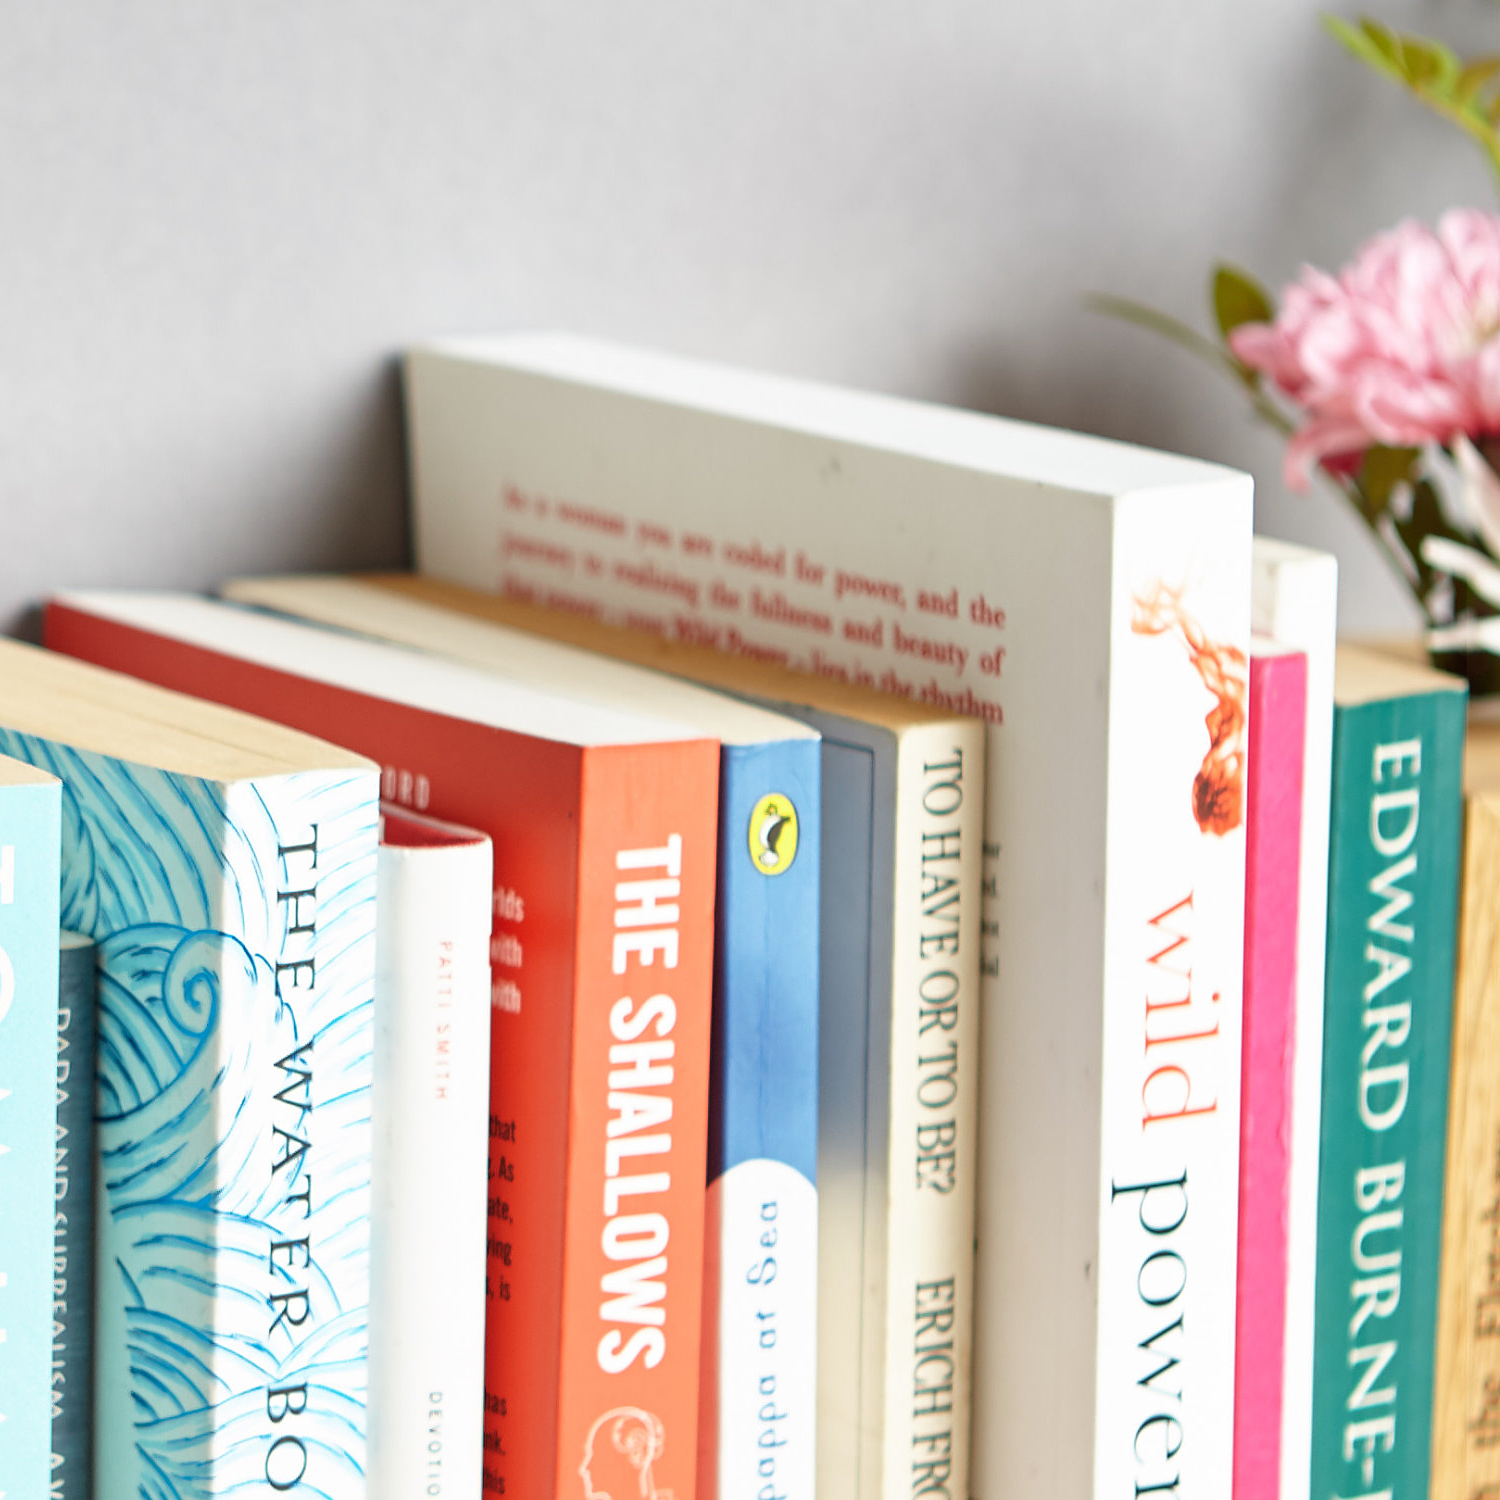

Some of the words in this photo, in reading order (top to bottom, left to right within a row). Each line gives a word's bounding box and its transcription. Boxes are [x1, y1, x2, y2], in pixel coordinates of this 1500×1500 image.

[843, 613, 884, 652] and
[893, 619, 969, 679] beauty
[979, 646, 1006, 678] of
[915, 585, 959, 622] and
[969, 593, 1006, 632] the
[922, 747, 963, 816] TO
[274, 823, 318, 998] THE
[612, 832, 682, 975] THE
[920, 827, 961, 960] HAVE
[1357, 736, 1422, 1133] EDWARD
[436, 940, 453, 1010] PATTI
[918, 970, 959, 1037] OR
[1142, 889, 1220, 1133] wild
[434, 1023, 452, 1101] SMITH
[917, 1039, 958, 1109] TO
[267, 1039, 314, 1340] WATER
[597, 993, 677, 1375] SHALLOWS
[916, 1118, 956, 1195] BE?
[746, 1200, 779, 1287] Sea
[912, 1275, 955, 1418] ERICH
